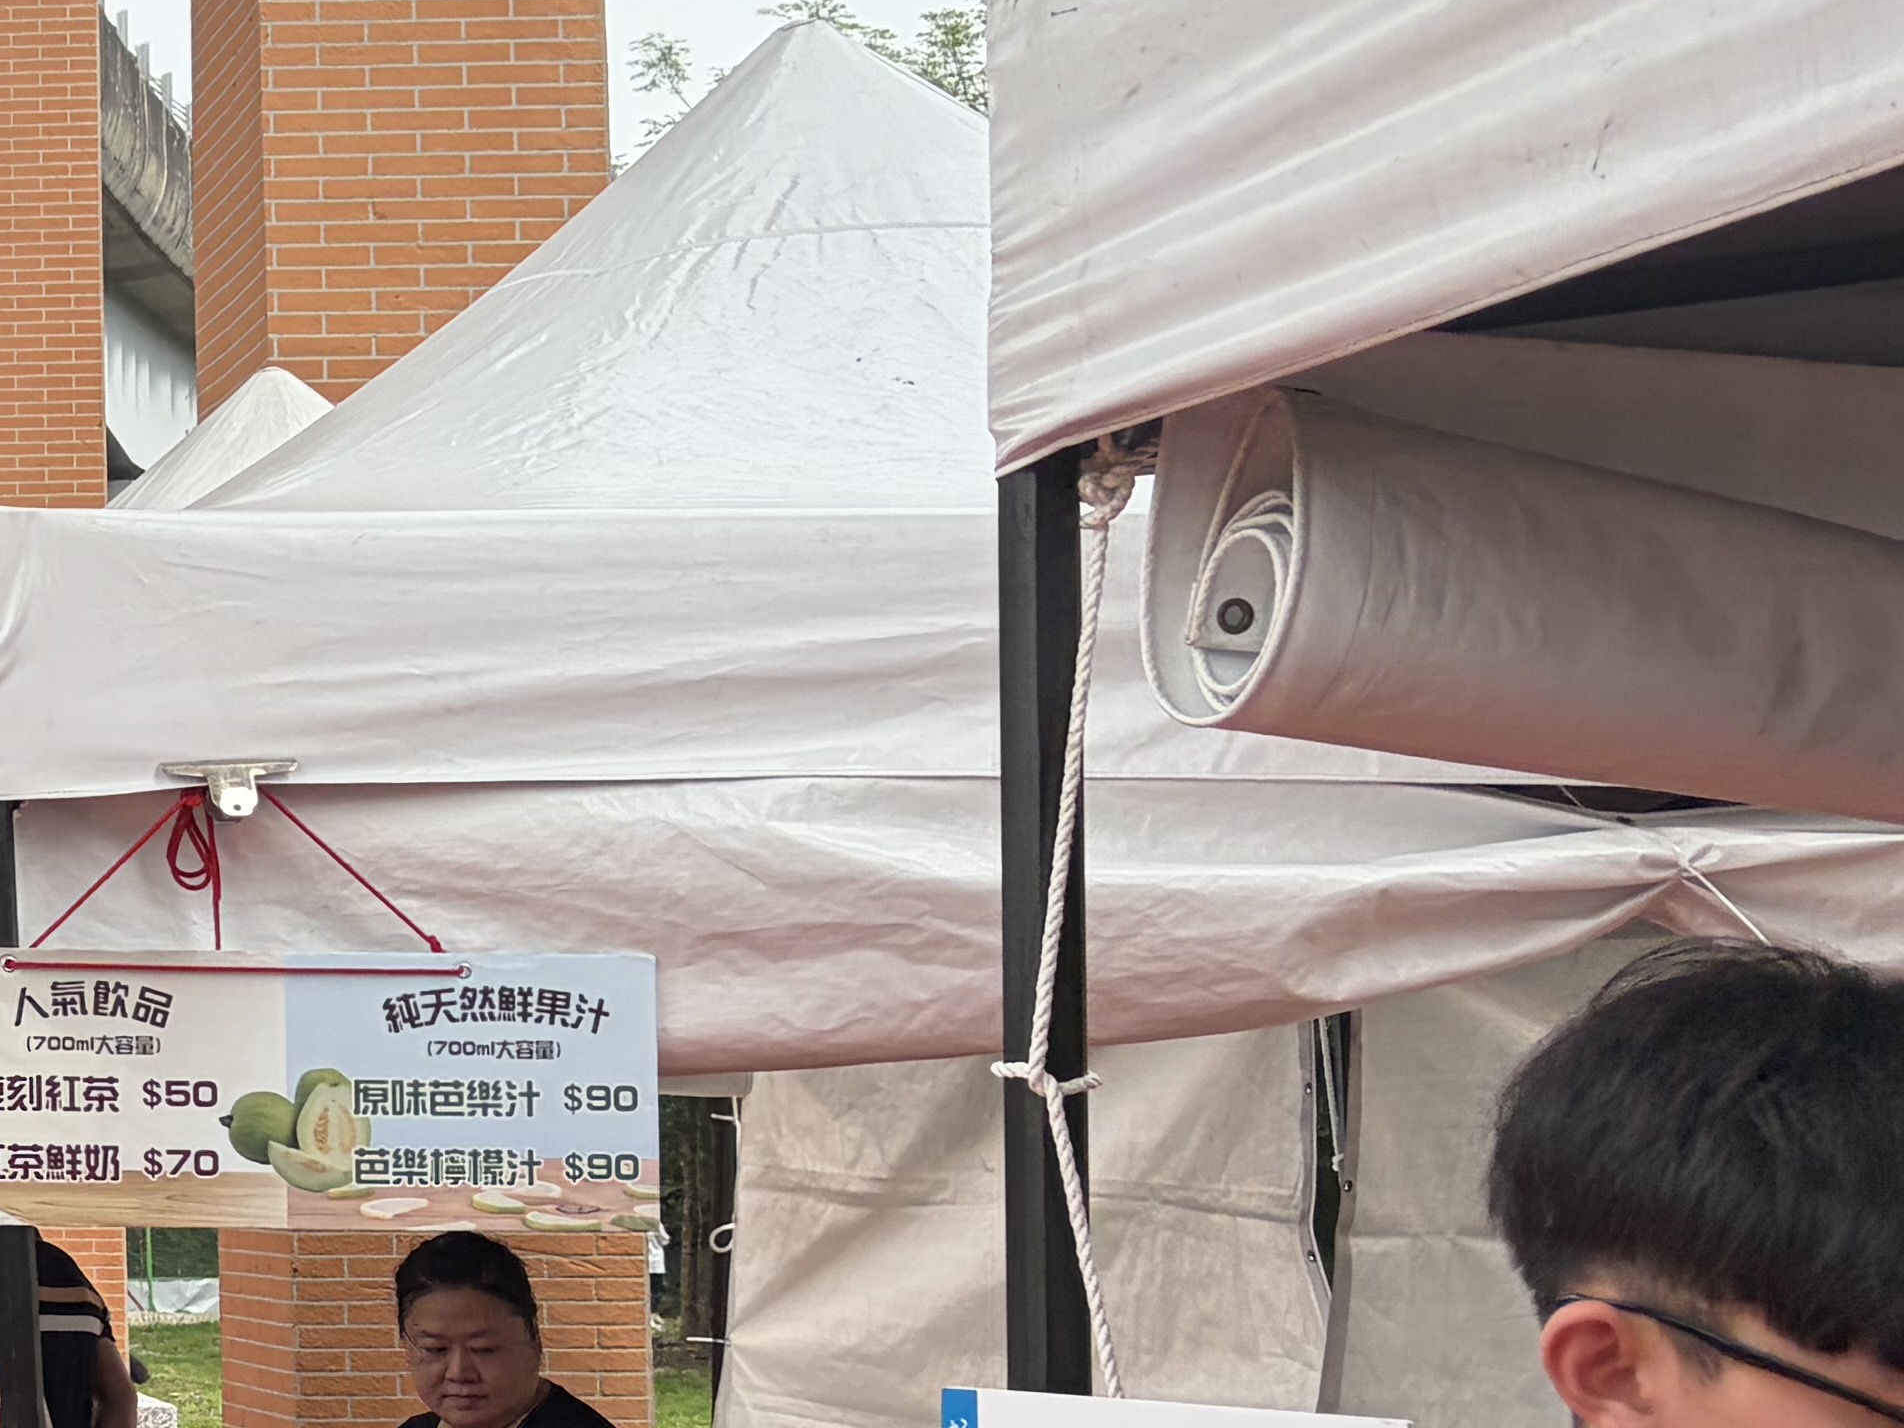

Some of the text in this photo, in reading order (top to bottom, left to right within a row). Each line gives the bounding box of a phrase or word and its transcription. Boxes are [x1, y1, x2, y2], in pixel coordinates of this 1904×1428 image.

[14, 980, 173, 1029] 人氣飲品
[382, 986, 610, 1034] 純天然鮮果汁
[26, 1035, 161, 1056] (700ml大容量)
[427, 1040, 561, 1061] (700ml大容量)
[142, 1078, 219, 1110] $50
[353, 1079, 639, 1117] 原味芭樂汁 $90
[143, 1147, 220, 1178] $70
[353, 1148, 640, 1186] 芭樂檸檬汁 $90
